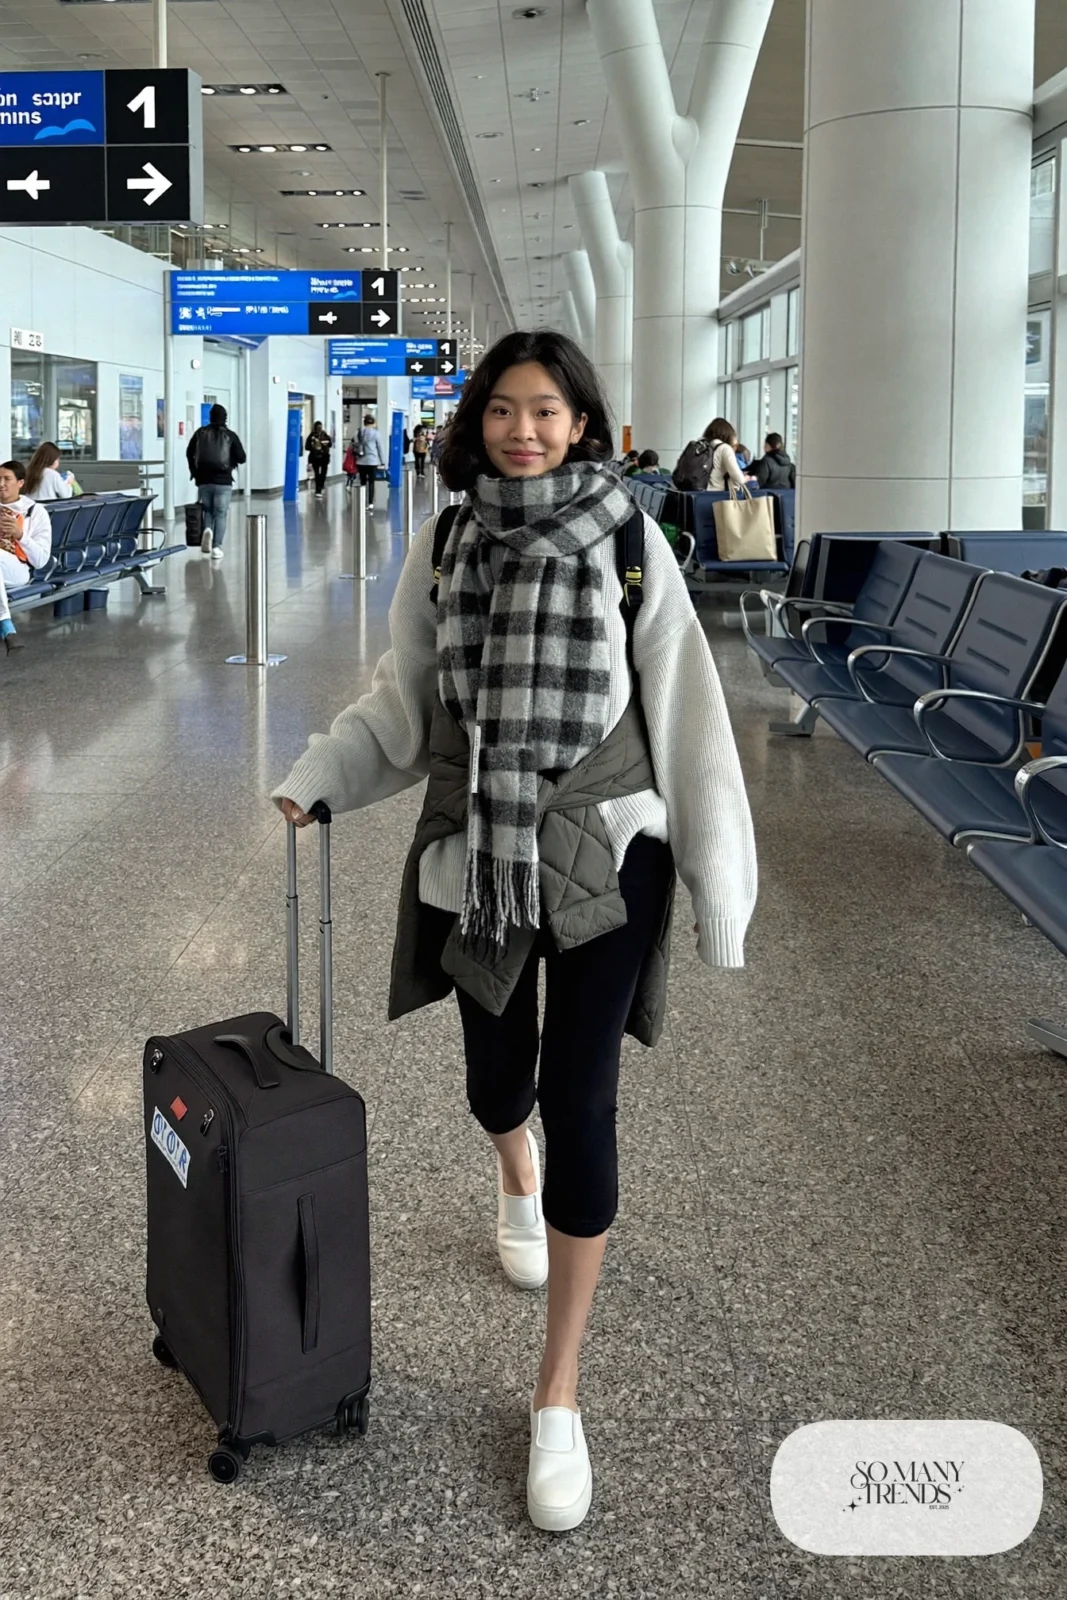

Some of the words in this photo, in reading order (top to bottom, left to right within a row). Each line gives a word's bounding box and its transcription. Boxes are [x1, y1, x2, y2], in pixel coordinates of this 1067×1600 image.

[127, 86, 156, 128] 1
[371, 277, 385, 296] 1
[440, 342, 450, 355] 1
